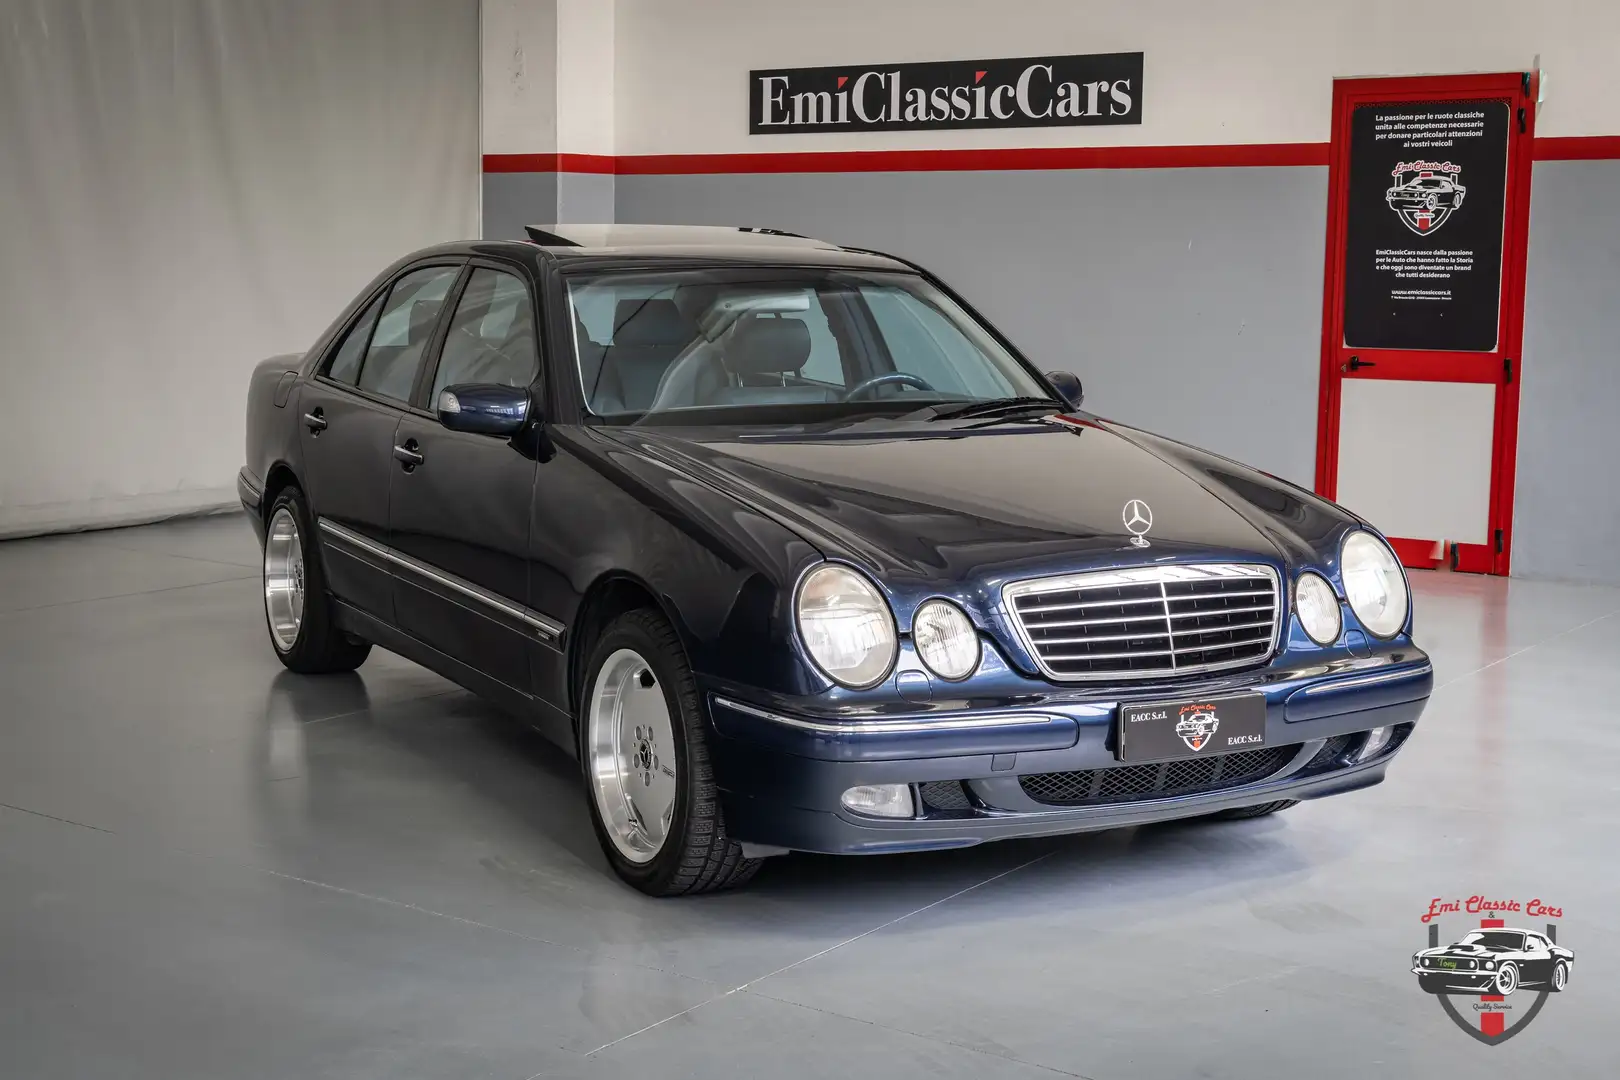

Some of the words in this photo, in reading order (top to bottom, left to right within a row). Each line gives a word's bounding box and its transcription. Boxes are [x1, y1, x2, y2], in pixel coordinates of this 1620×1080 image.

[758, 64, 1132, 126] EmiClassicCars
[1384, 114, 1414, 122] passione
[1454, 111, 1485, 119] classiche
[1393, 122, 1406, 130] alle
[1406, 122, 1447, 130] competenze
[1448, 120, 1484, 128] necessarie
[1412, 131, 1447, 139] particolari
[1447, 129, 1483, 137] attenzioni
[1430, 139, 1453, 147] veicoli
[1392, 161, 1413, 177] Emi
[1413, 160, 1440, 172] Classic
[1441, 161, 1462, 173] Cars
[1447, 249, 1473, 257] passione
[1130, 712, 1151, 723] EACC
[1227, 735, 1247, 745] EACC
